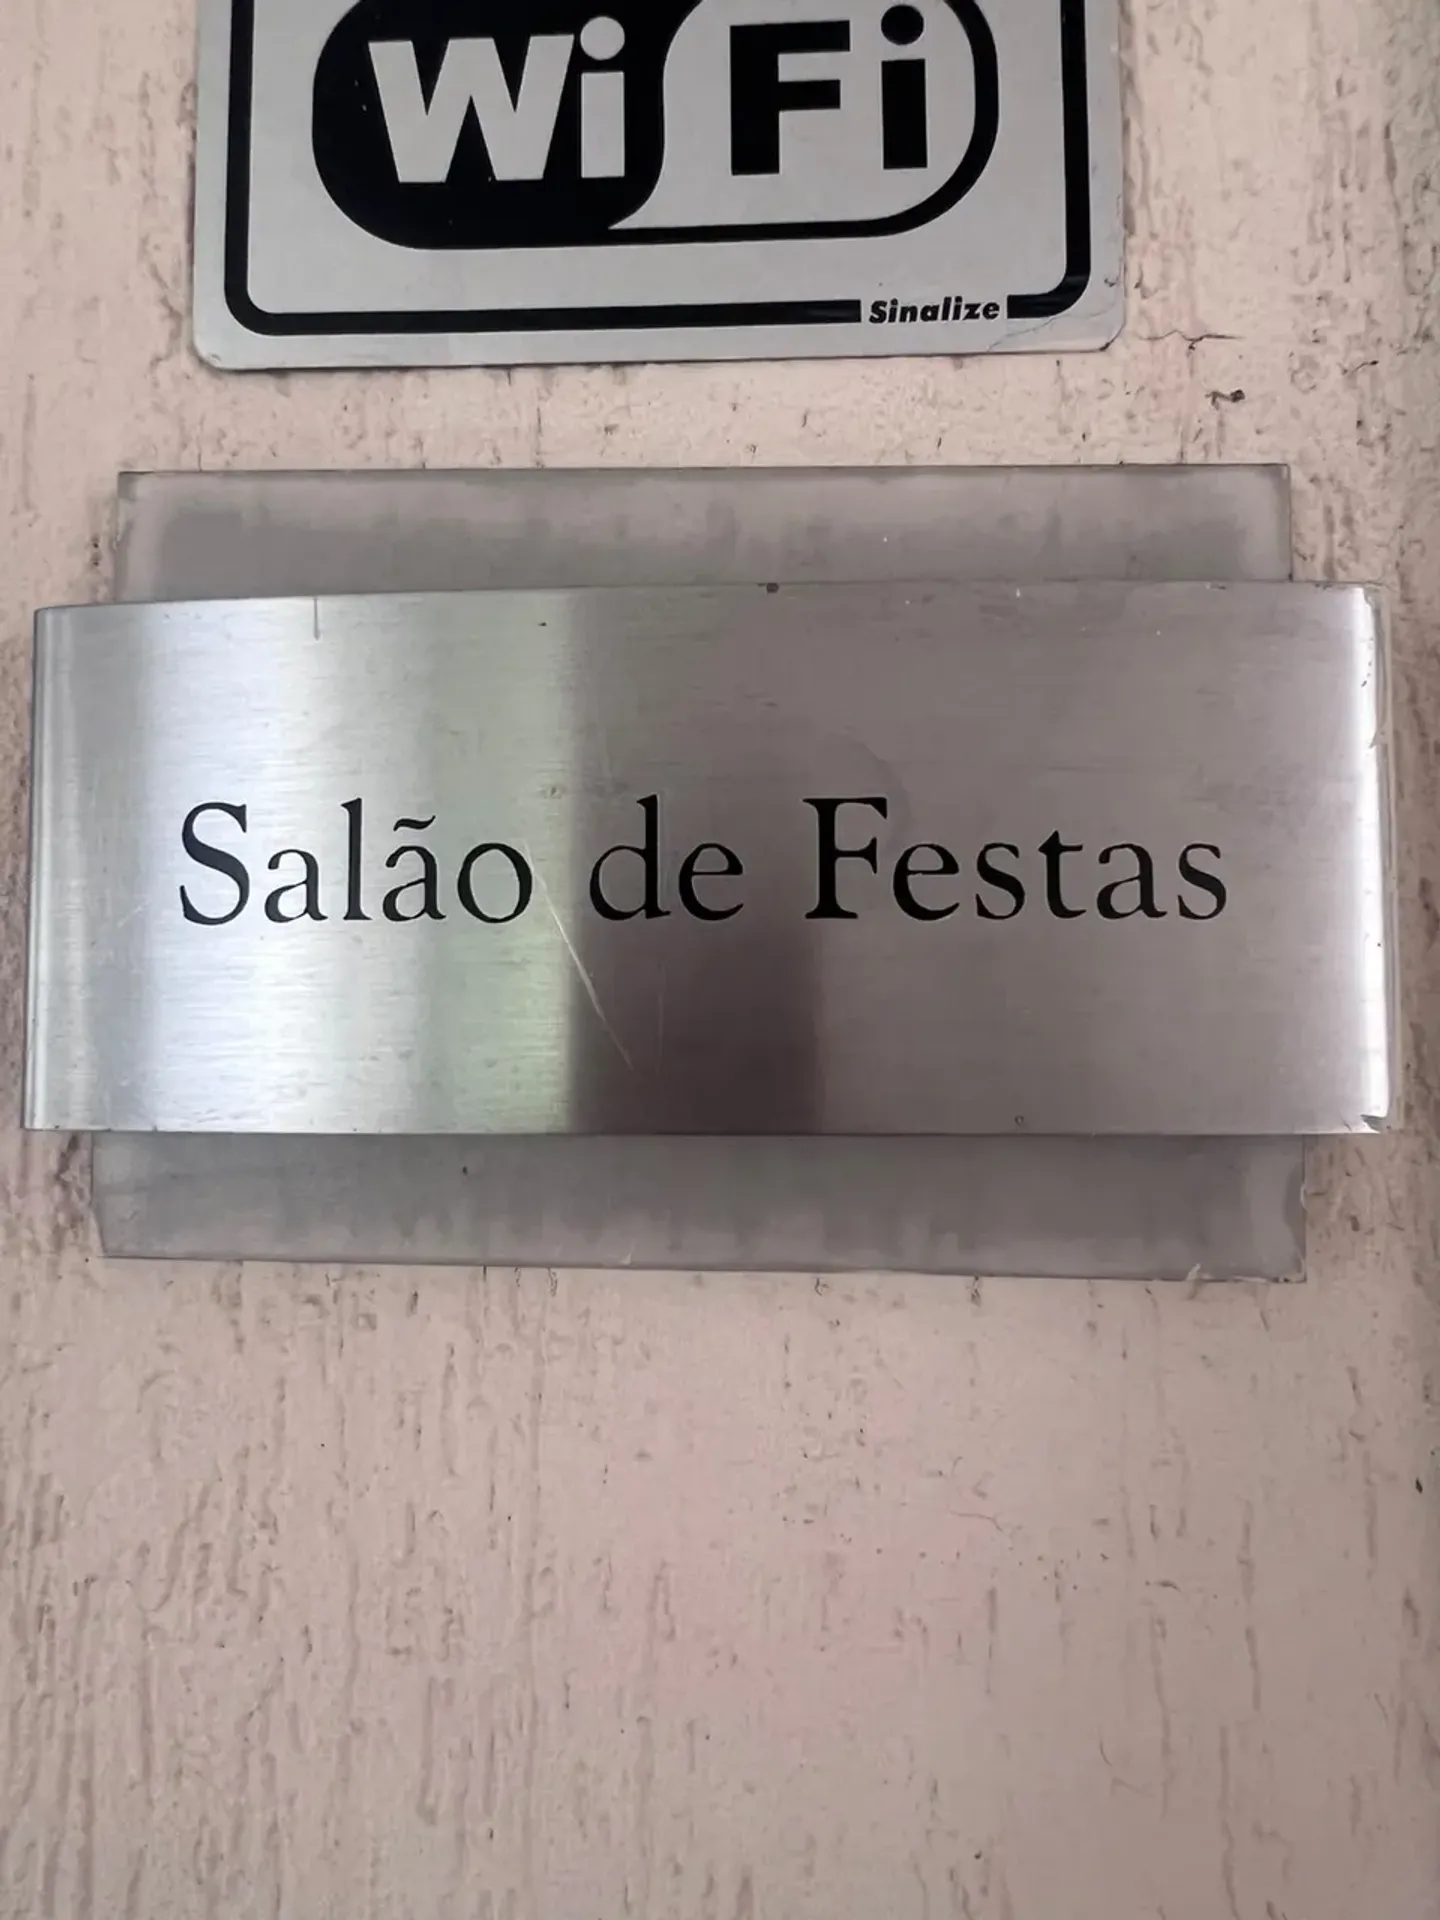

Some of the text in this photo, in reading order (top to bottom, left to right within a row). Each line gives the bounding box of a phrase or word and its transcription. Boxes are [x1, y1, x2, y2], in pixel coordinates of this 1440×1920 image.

[369, 4, 929, 184] Wi Fi
[868, 296, 1002, 325] Sinalize
[179, 794, 1228, 926] Salão de Festas
